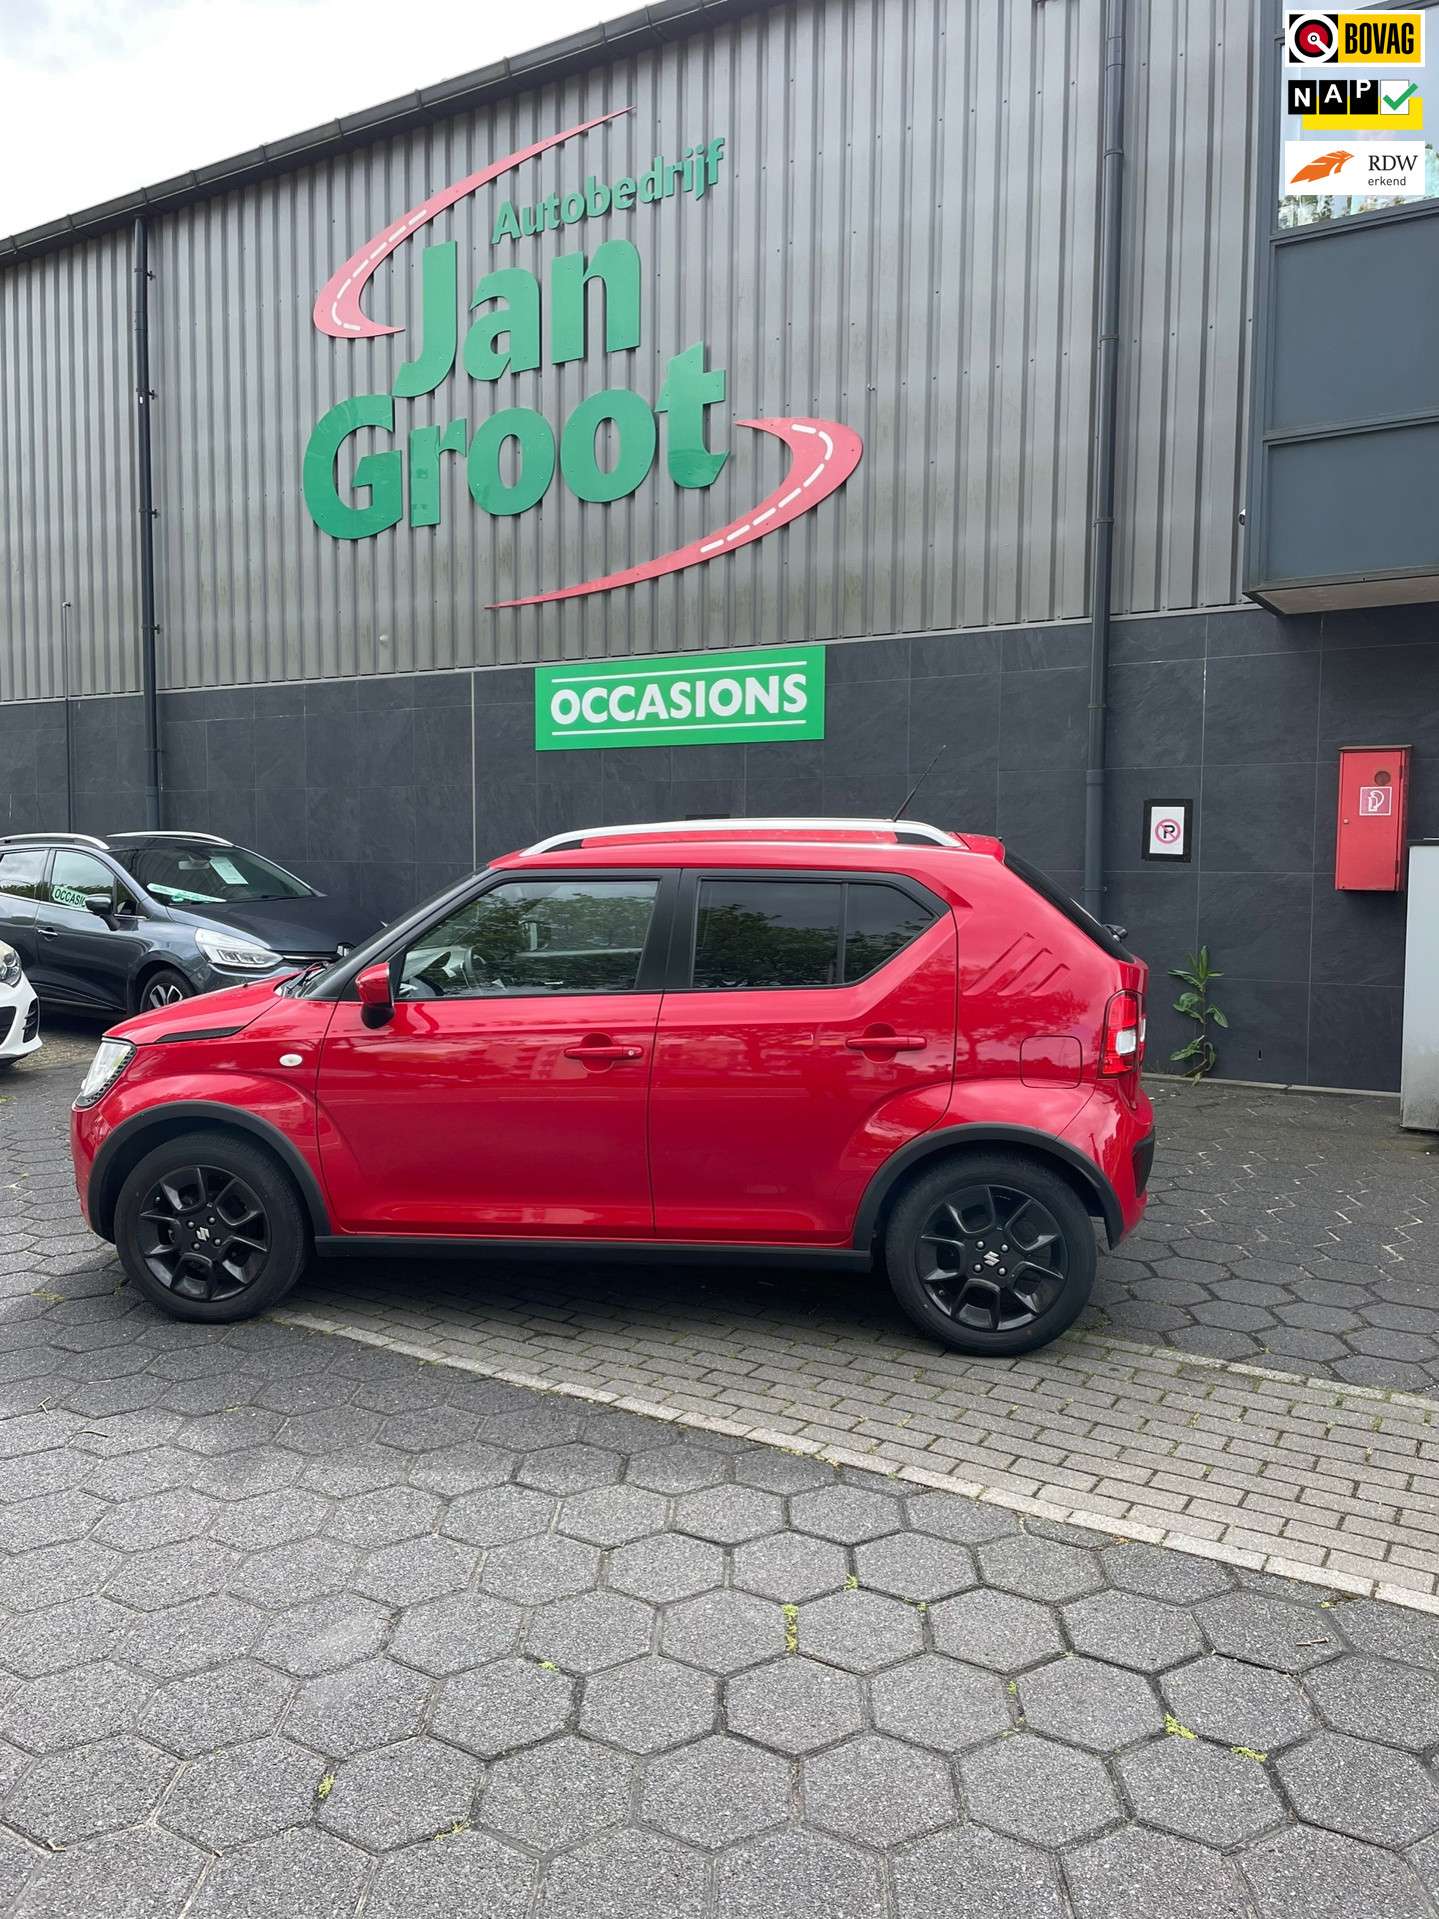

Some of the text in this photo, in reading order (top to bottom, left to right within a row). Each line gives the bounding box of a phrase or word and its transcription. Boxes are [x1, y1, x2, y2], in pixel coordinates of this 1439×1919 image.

[489, 136, 726, 245] Autobedrijf
[392, 239, 641, 399] Jan
[303, 341, 731, 540] Groot
[550, 673, 808, 726] OCCASIONS
